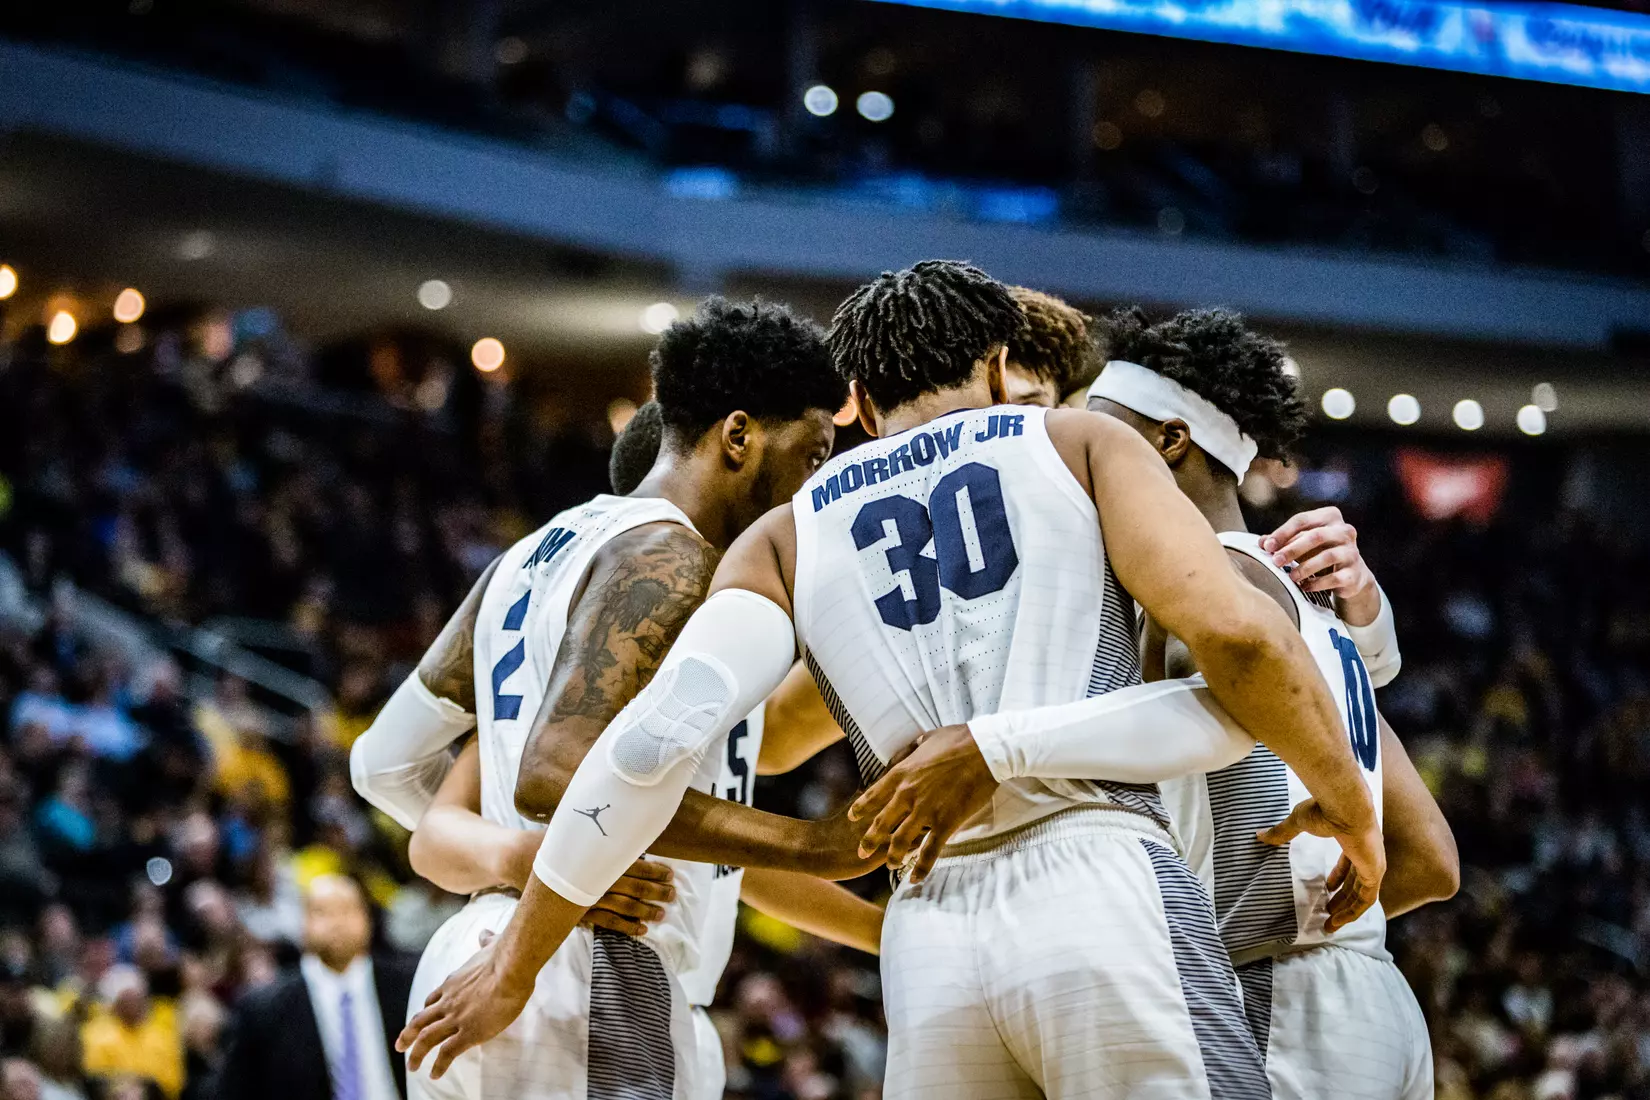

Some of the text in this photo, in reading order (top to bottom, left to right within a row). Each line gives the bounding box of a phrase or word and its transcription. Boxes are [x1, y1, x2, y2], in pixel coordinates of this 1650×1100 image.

[811, 414, 1025, 513] MORROW JR
[850, 461, 1019, 632] 30
[491, 589, 532, 720] 2
